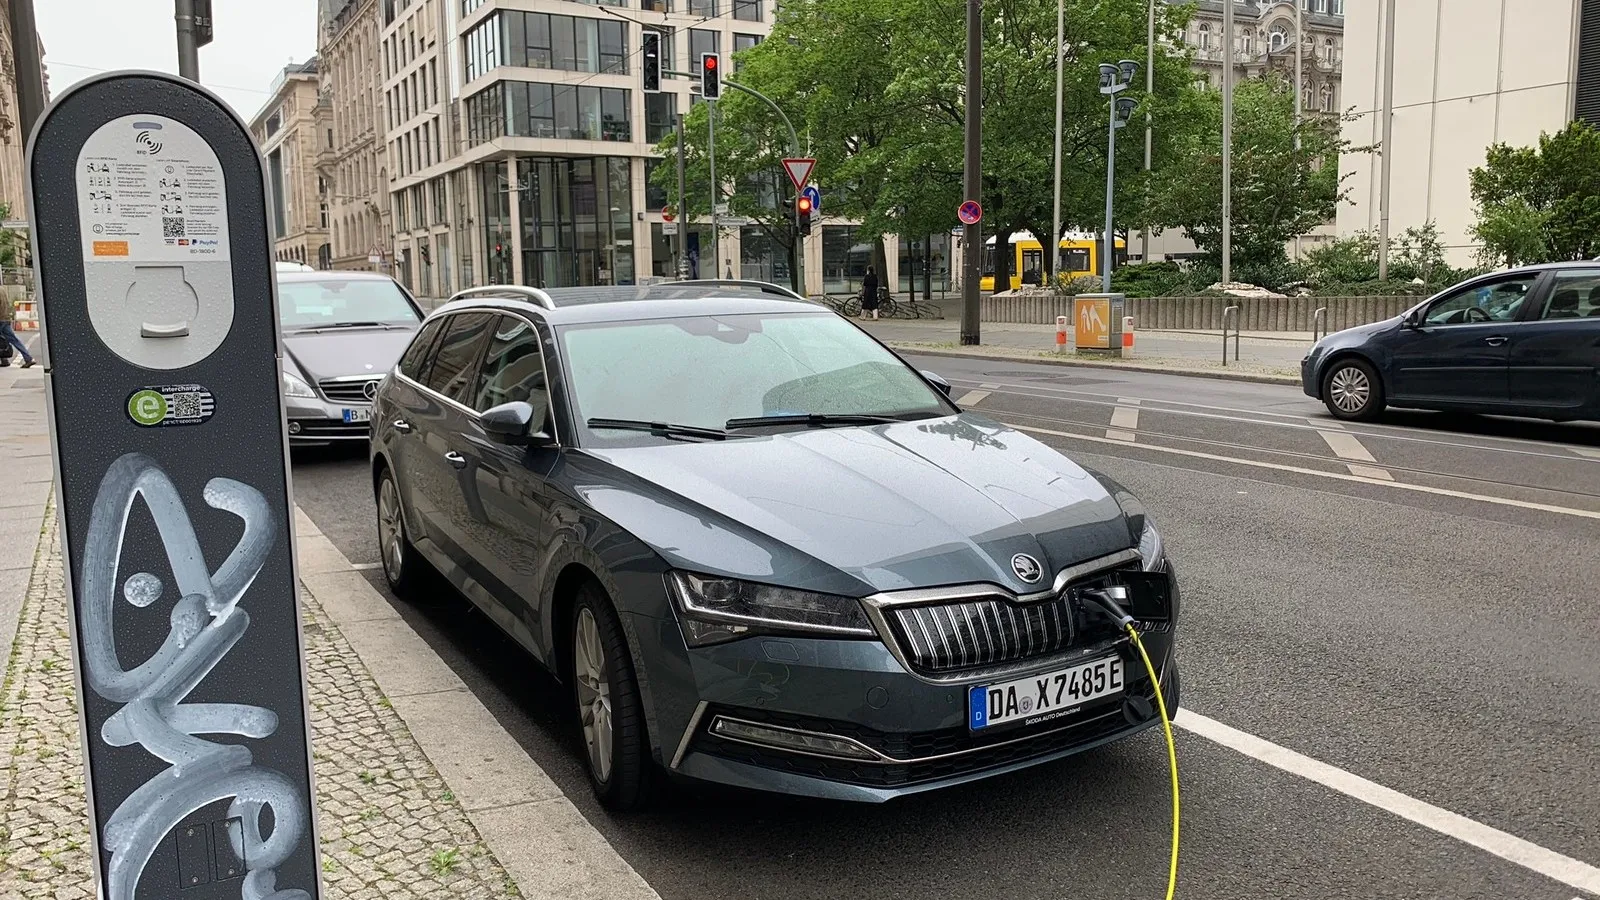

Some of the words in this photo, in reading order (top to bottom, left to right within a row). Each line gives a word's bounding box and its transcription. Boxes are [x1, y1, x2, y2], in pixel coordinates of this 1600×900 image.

[351, 410, 358, 420] B
[976, 711, 982, 721] D
[988, 686, 1019, 720] DA
[1056, 706, 1081, 717] Deutschland
